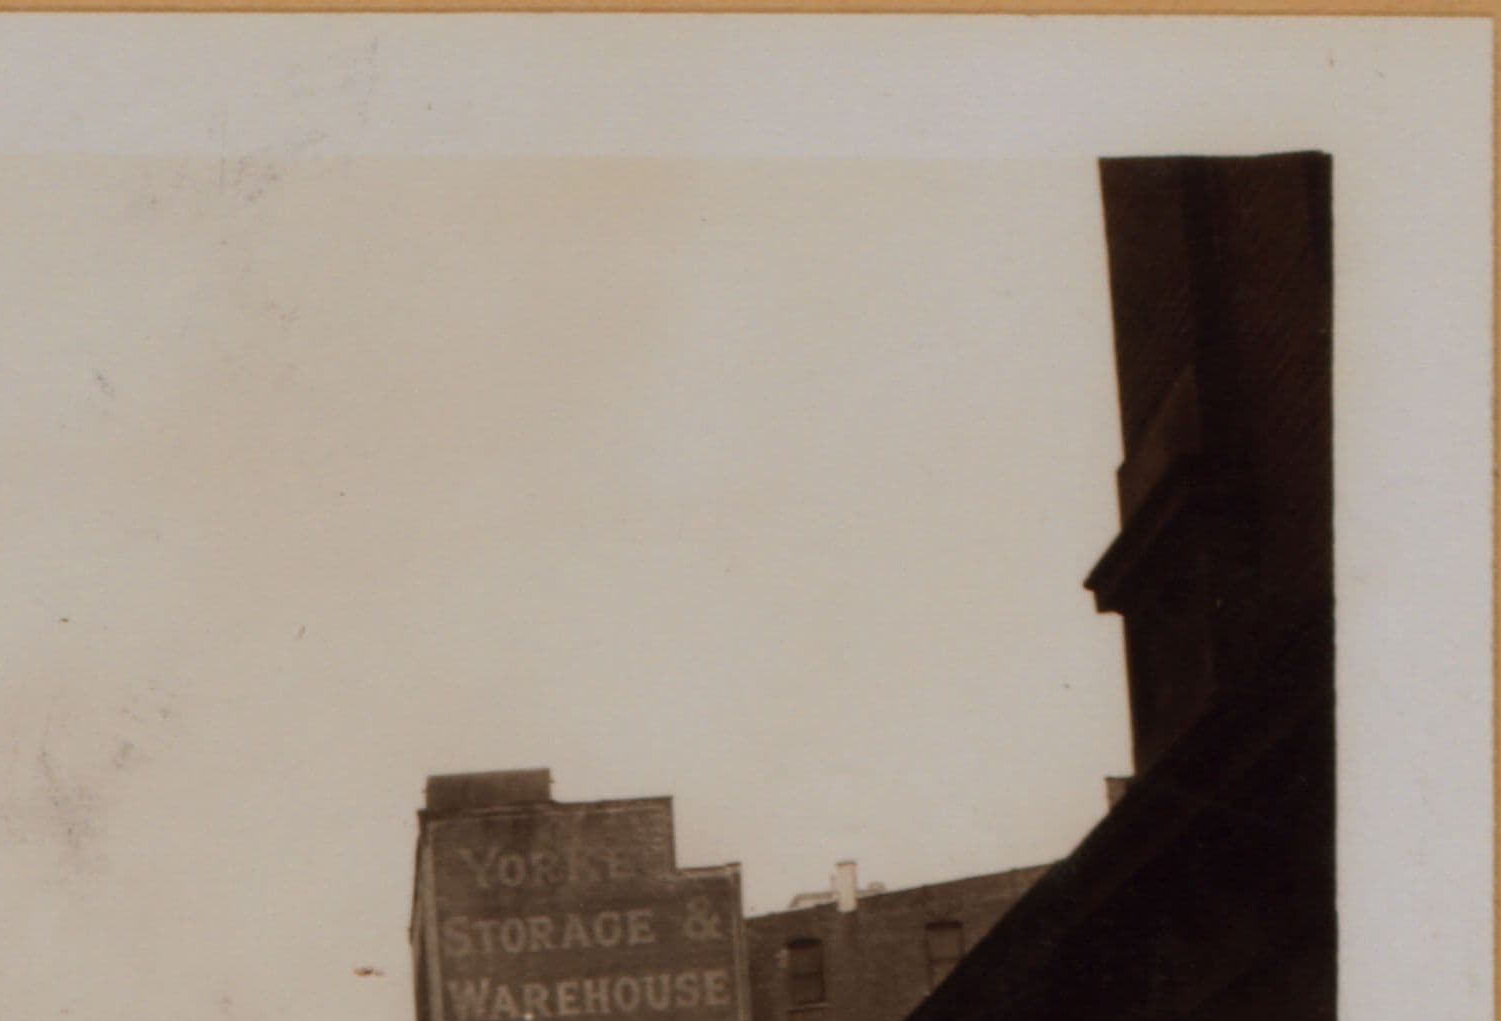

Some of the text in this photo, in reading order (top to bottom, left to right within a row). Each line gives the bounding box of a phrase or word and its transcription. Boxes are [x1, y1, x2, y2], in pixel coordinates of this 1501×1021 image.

[458, 845, 635, 889] YORKE
[442, 896, 723, 958] STORAGE &
